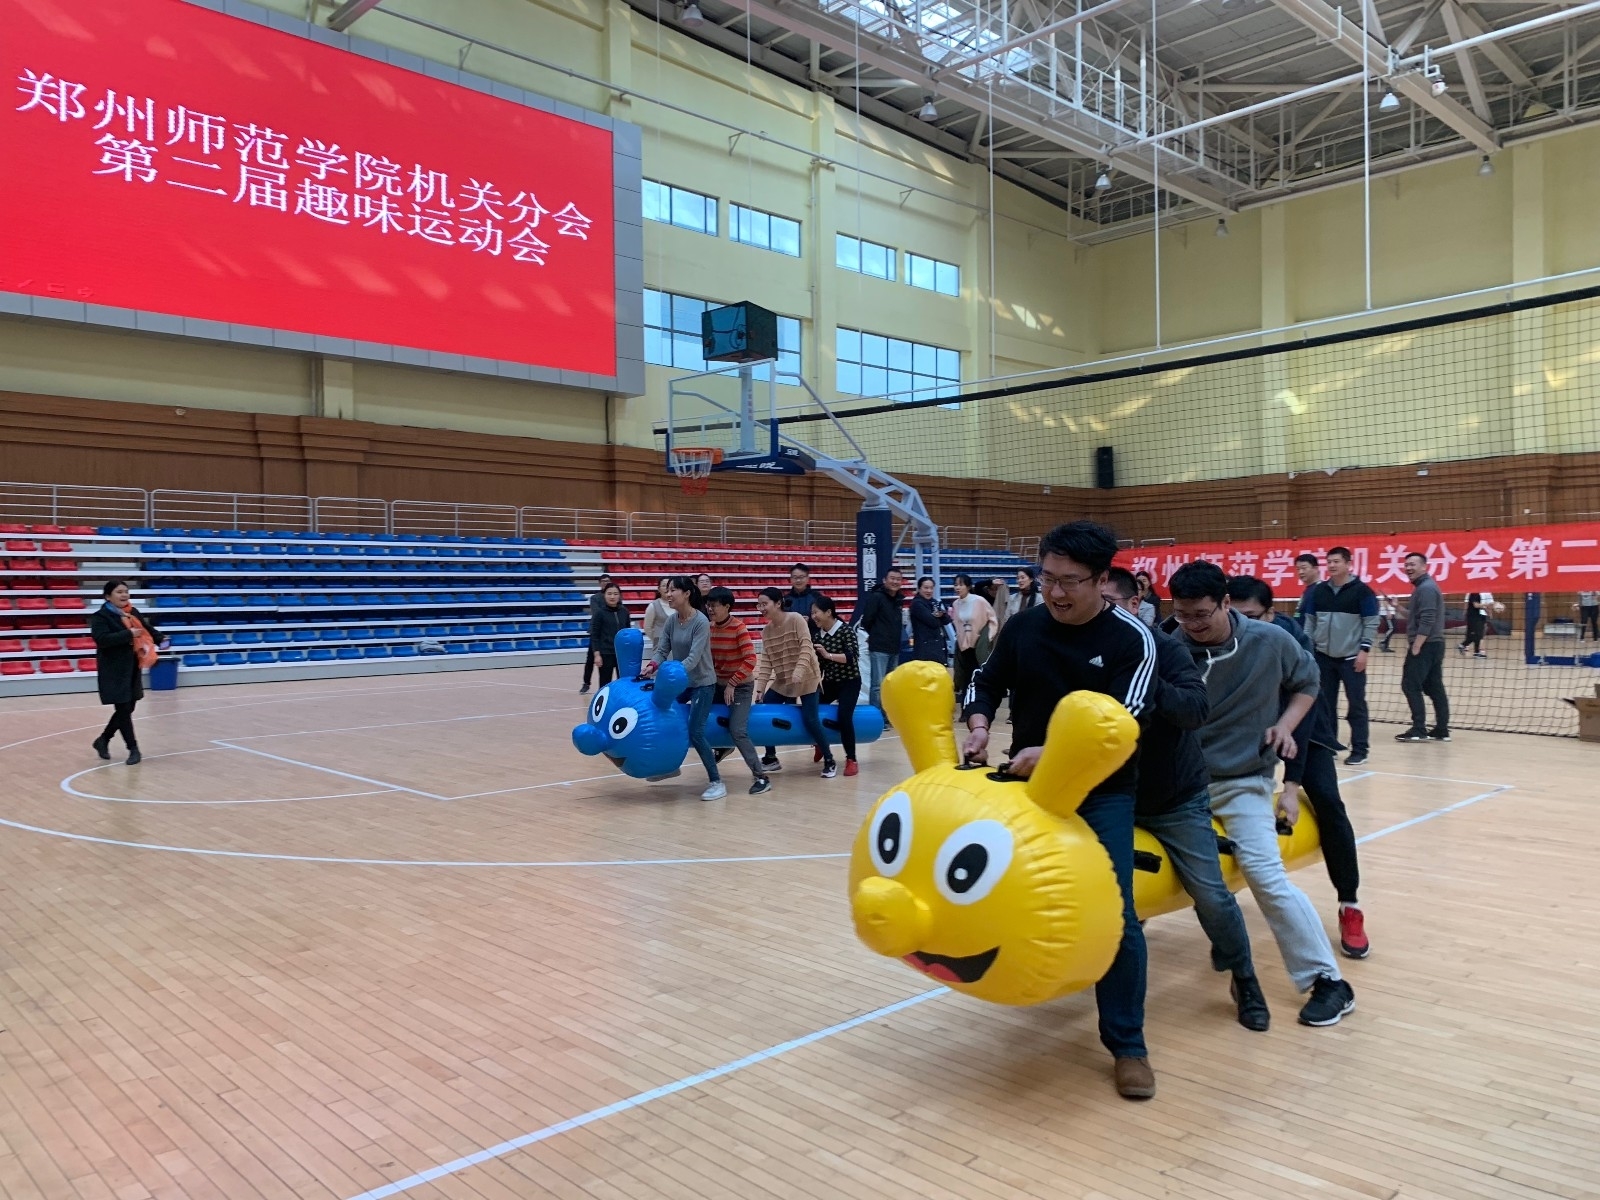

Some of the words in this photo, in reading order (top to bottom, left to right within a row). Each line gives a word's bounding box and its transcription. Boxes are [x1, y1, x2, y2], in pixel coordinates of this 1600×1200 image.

[15, 68, 593, 242] 郑州师范学院机关分会
[92, 132, 552, 267] 第二届趣味运动会
